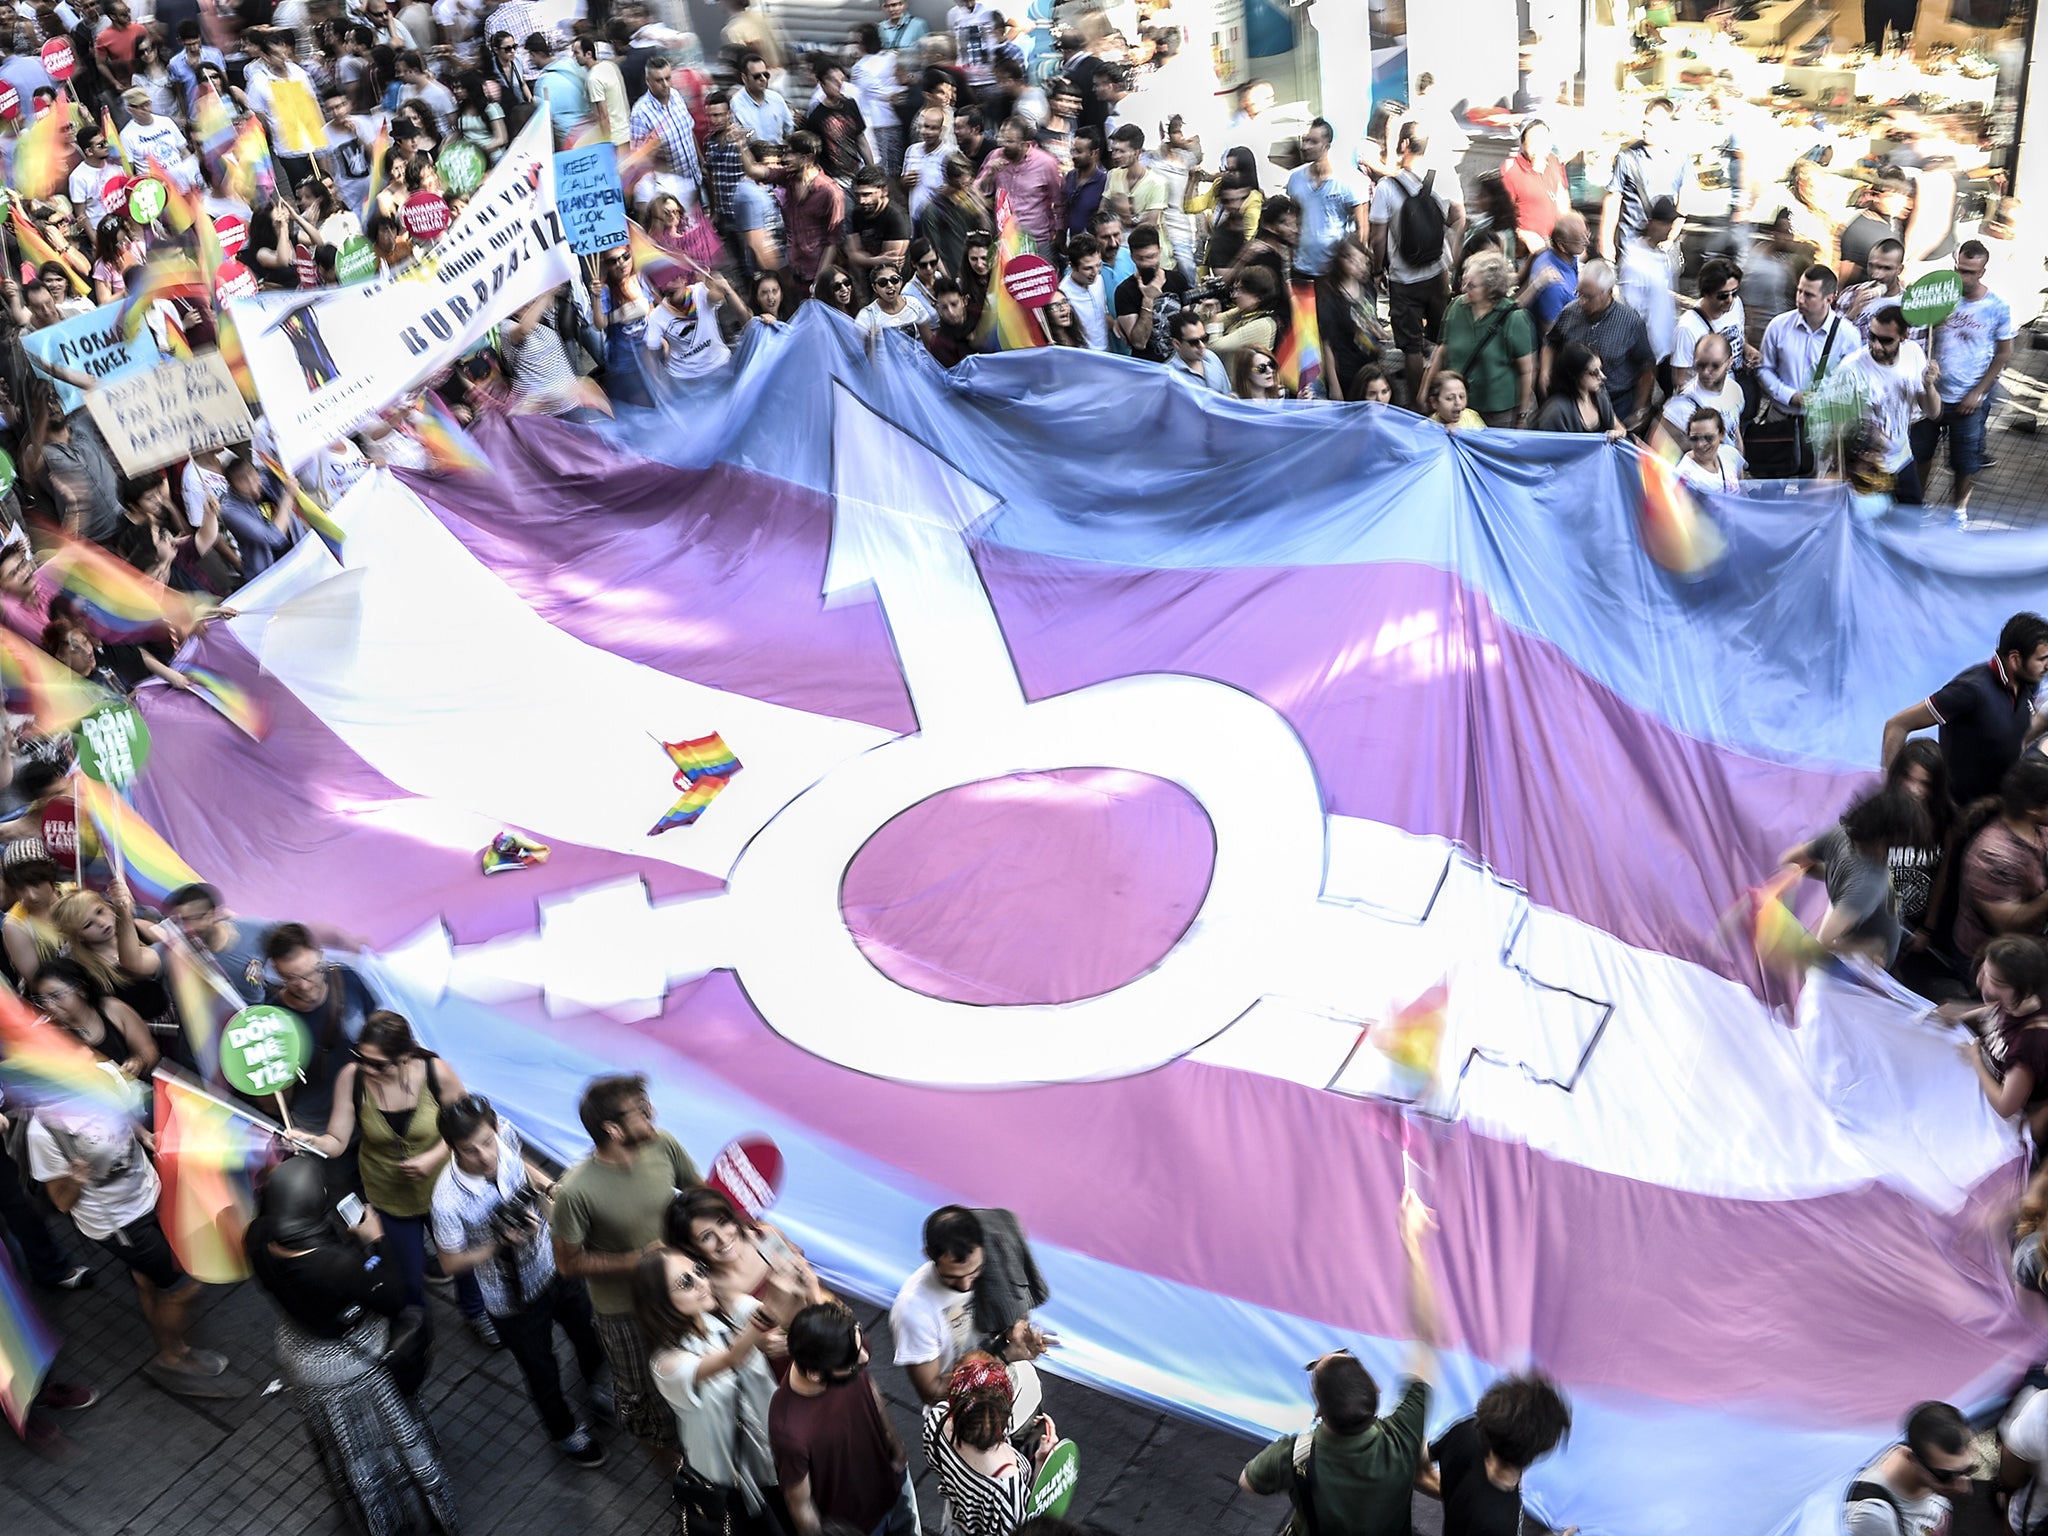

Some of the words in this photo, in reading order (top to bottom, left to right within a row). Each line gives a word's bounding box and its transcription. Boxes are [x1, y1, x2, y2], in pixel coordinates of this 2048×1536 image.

[563, 153, 600, 175] KEEP
[561, 172, 608, 194] CALM
[556, 188, 623, 213] TRANSMEN
[571, 210, 606, 226] LOOK
[579, 224, 596, 235] and
[594, 230, 629, 248] BETTER
[59, 325, 127, 366] NORMA
[81, 707, 137, 740] DÖN
[91, 730, 130, 754] ME
[227, 1012, 288, 1049] DÖN
[242, 1036, 284, 1067] ME
[246, 1059, 291, 1090] YİZ
